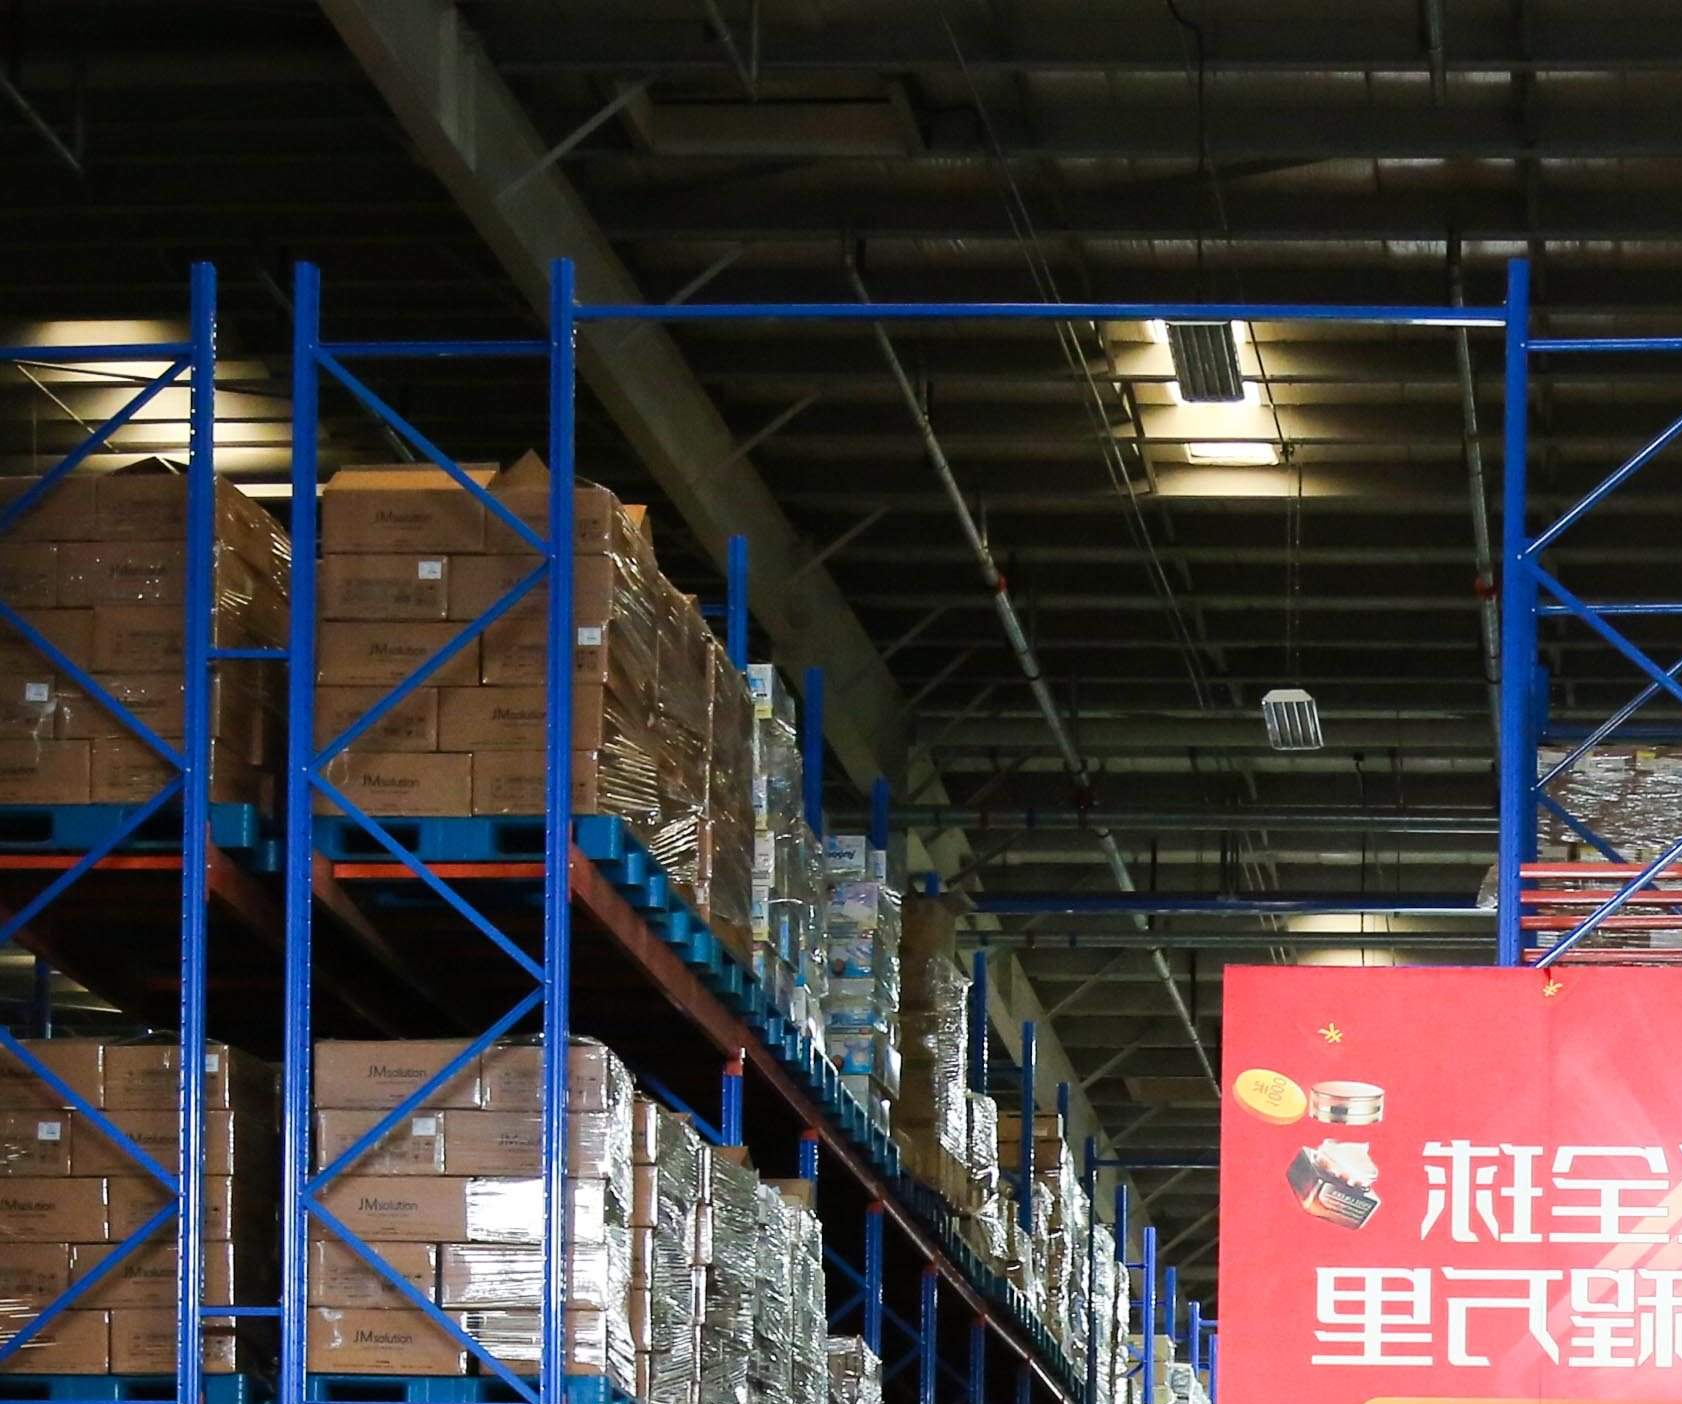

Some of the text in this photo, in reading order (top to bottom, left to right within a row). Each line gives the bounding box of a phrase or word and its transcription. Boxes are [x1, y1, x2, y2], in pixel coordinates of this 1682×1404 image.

[368, 1066, 427, 1078] JMsolution
[358, 1199, 418, 1212] JMsolution
[353, 1332, 413, 1345] JMsolution
